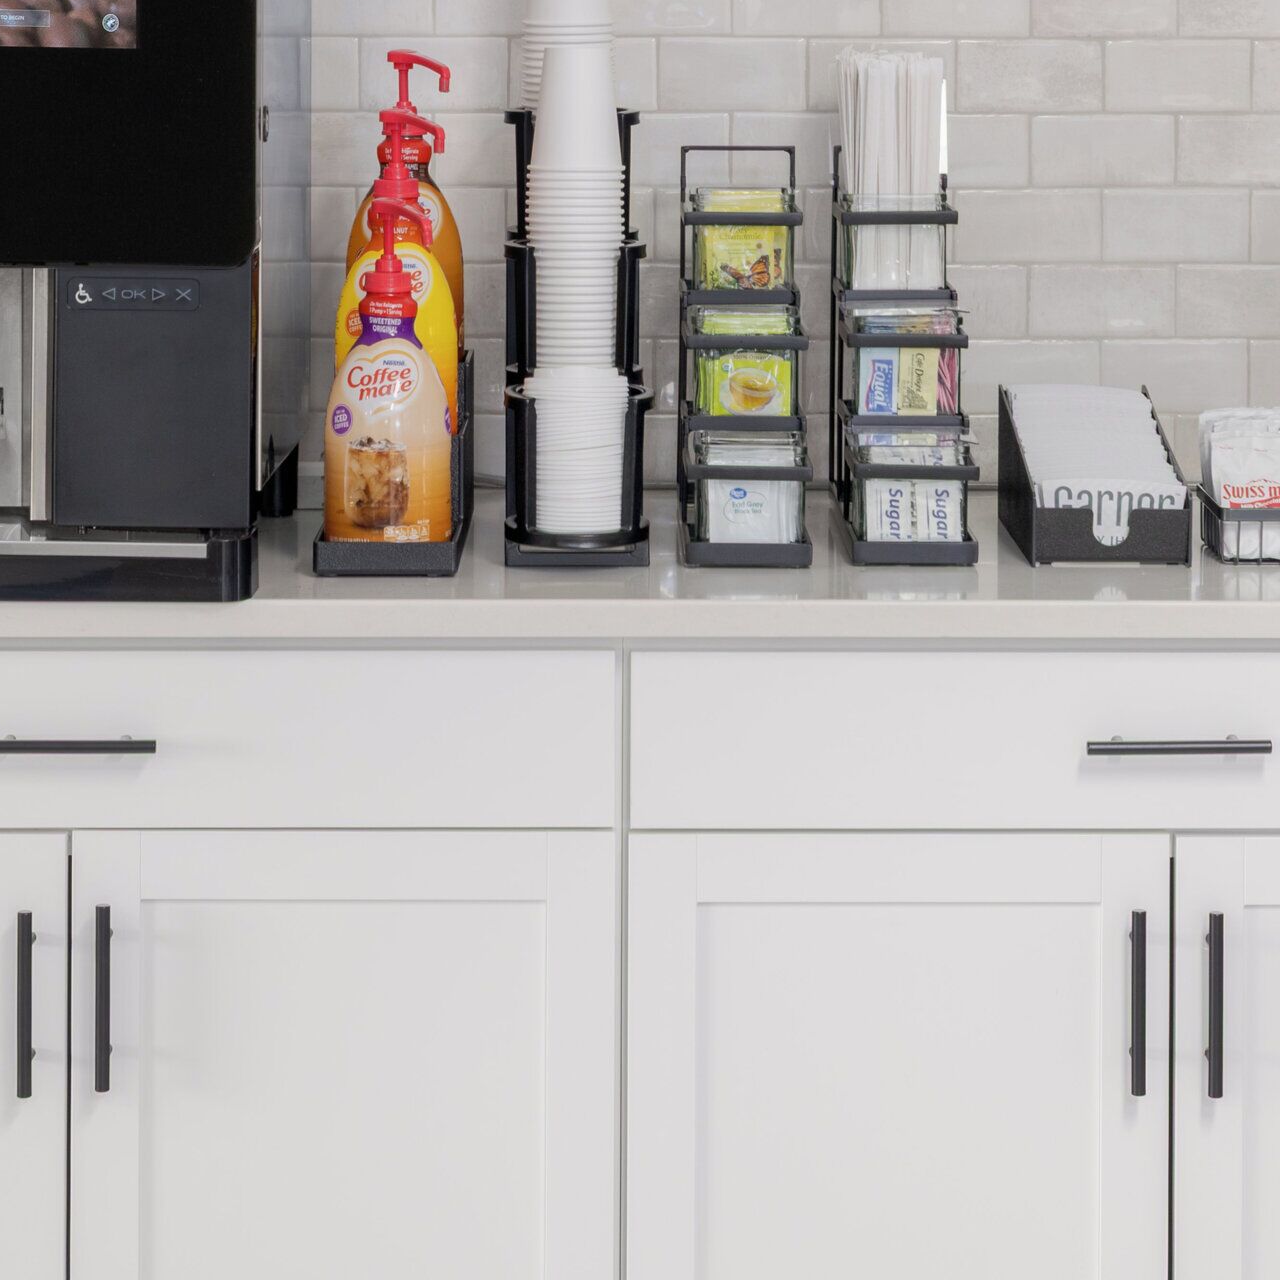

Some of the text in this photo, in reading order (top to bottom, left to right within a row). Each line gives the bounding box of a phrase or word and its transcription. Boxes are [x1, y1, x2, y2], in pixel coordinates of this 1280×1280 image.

[121, 289, 147, 300] OK
[369, 316, 402, 326] SWEETENED
[347, 365, 412, 388] Coffee
[885, 487, 903, 540] Sugar
[932, 488, 950, 540] Sugar
